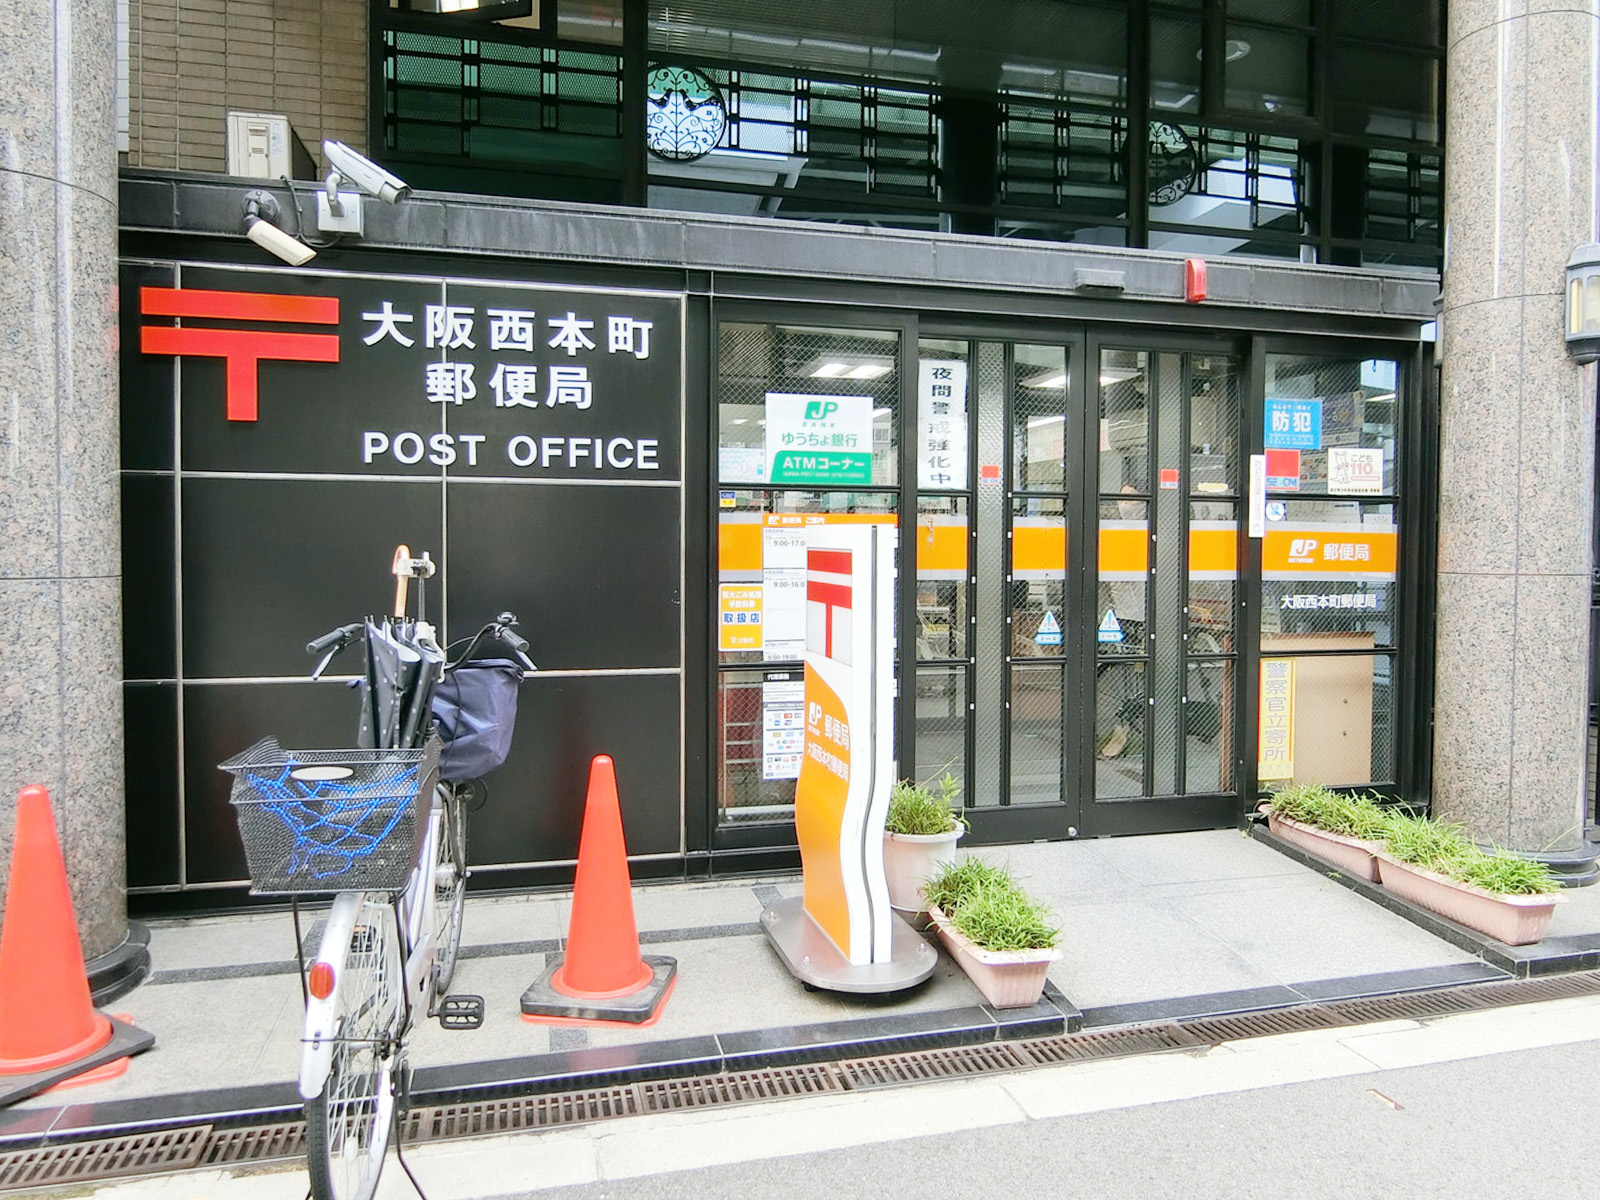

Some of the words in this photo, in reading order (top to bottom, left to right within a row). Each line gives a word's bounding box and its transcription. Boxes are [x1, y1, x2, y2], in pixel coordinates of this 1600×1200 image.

[362, 301, 654, 359] 大阪西本町
[425, 361, 593, 409] 郵便局
[1272, 410, 1312, 432] 防犯
[781, 432, 858, 448] ゆうちょ銀行
[363, 431, 486, 466] POST
[507, 435, 660, 470] OFFICE
[1351, 454, 1373, 462] こども
[782, 456, 866, 470] ATMコーナー
[1350, 463, 1373, 475] 110
[1266, 477, 1298, 487] SEOM
[1322, 543, 1371, 561] 郵便局
[1280, 594, 1377, 610] 大阪西本町郵便局
[723, 612, 760, 624] 取扱店
[1264, 662, 1288, 761] 警察官立寄所
[824, 714, 850, 751] 郵便局
